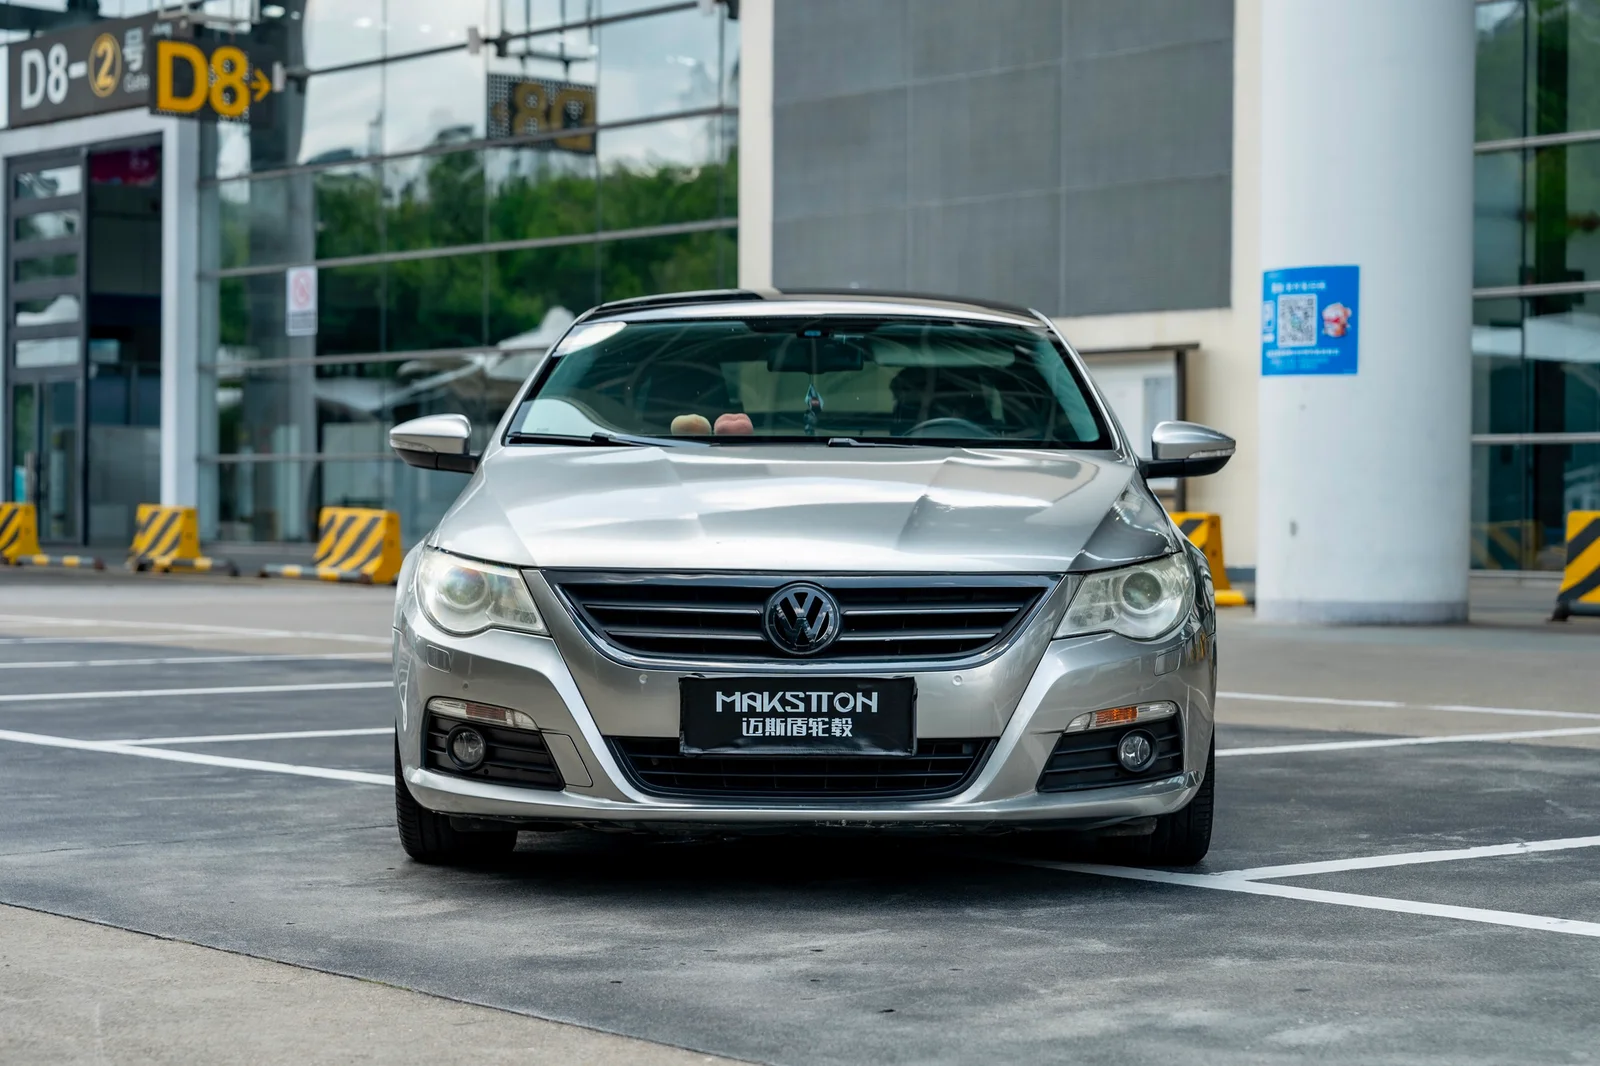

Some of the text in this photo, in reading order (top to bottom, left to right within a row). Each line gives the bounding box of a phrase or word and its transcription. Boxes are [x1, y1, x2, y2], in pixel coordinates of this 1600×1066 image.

[157, 40, 250, 117] D8
[716, 691, 878, 713] MAKSTTON
[742, 717, 853, 737] 迈斯盾轮毂
